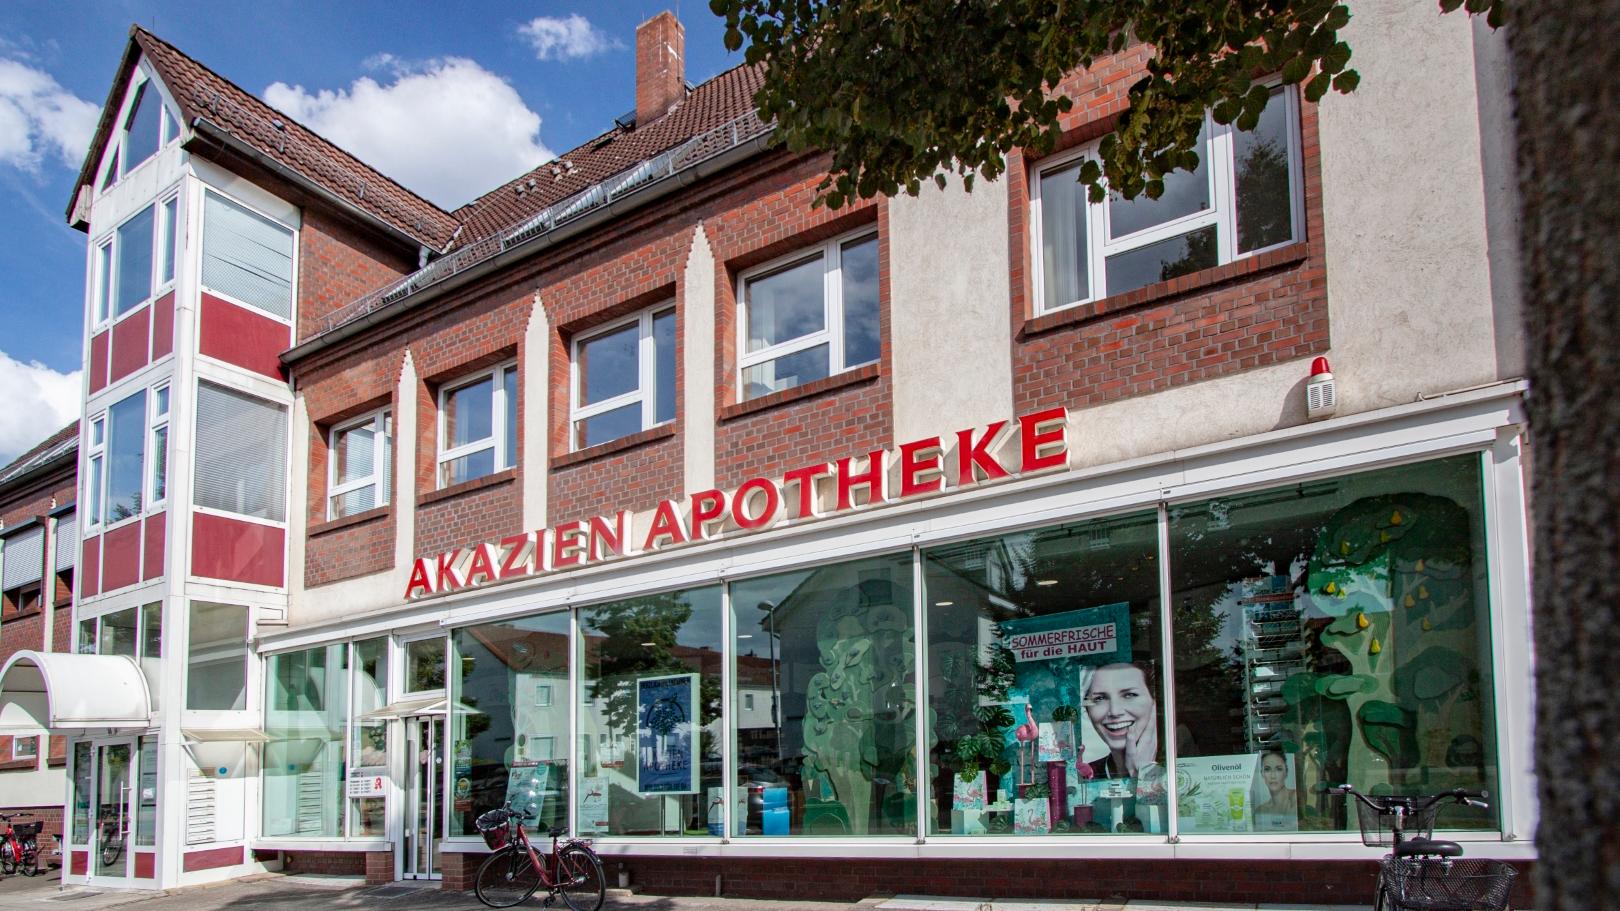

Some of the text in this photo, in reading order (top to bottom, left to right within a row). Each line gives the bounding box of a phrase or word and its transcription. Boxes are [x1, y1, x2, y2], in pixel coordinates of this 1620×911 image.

[404, 406, 1071, 598] AKAZIEN APOTHEKE
[1011, 624, 1114, 648] SOMMERFRISCHE
[1021, 640, 1107, 659] für die HAUT
[1211, 762, 1242, 771] Olivenöl
